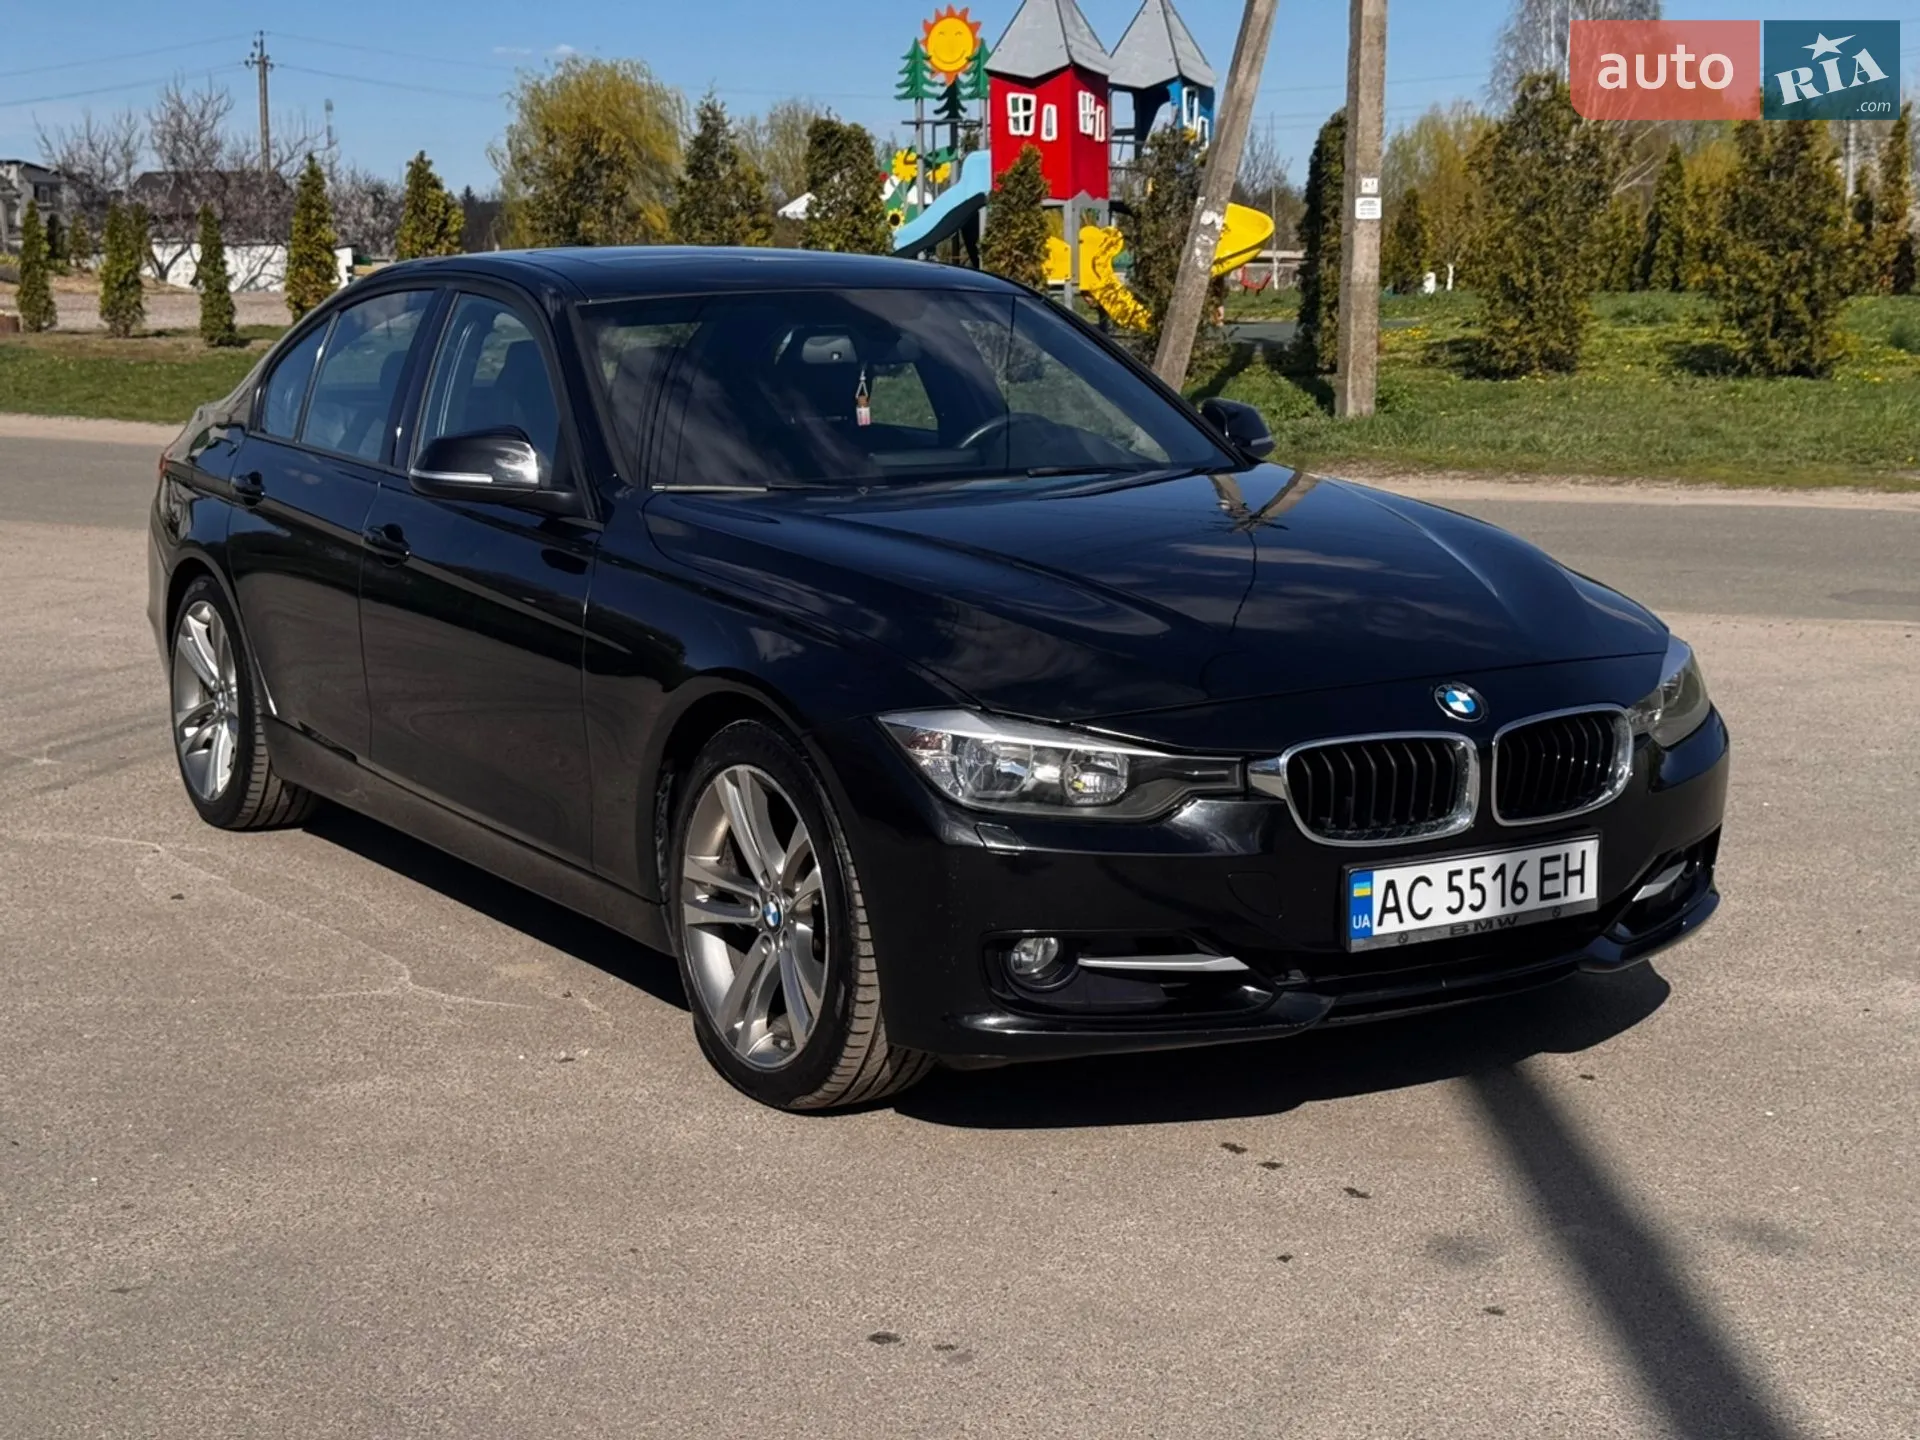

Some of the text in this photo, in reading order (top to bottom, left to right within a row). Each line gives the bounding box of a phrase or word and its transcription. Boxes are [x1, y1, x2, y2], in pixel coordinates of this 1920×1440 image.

[1377, 849, 1586, 927] AC 5516 EH
[1352, 914, 1371, 929] UA
[1449, 915, 1519, 937] BMW
